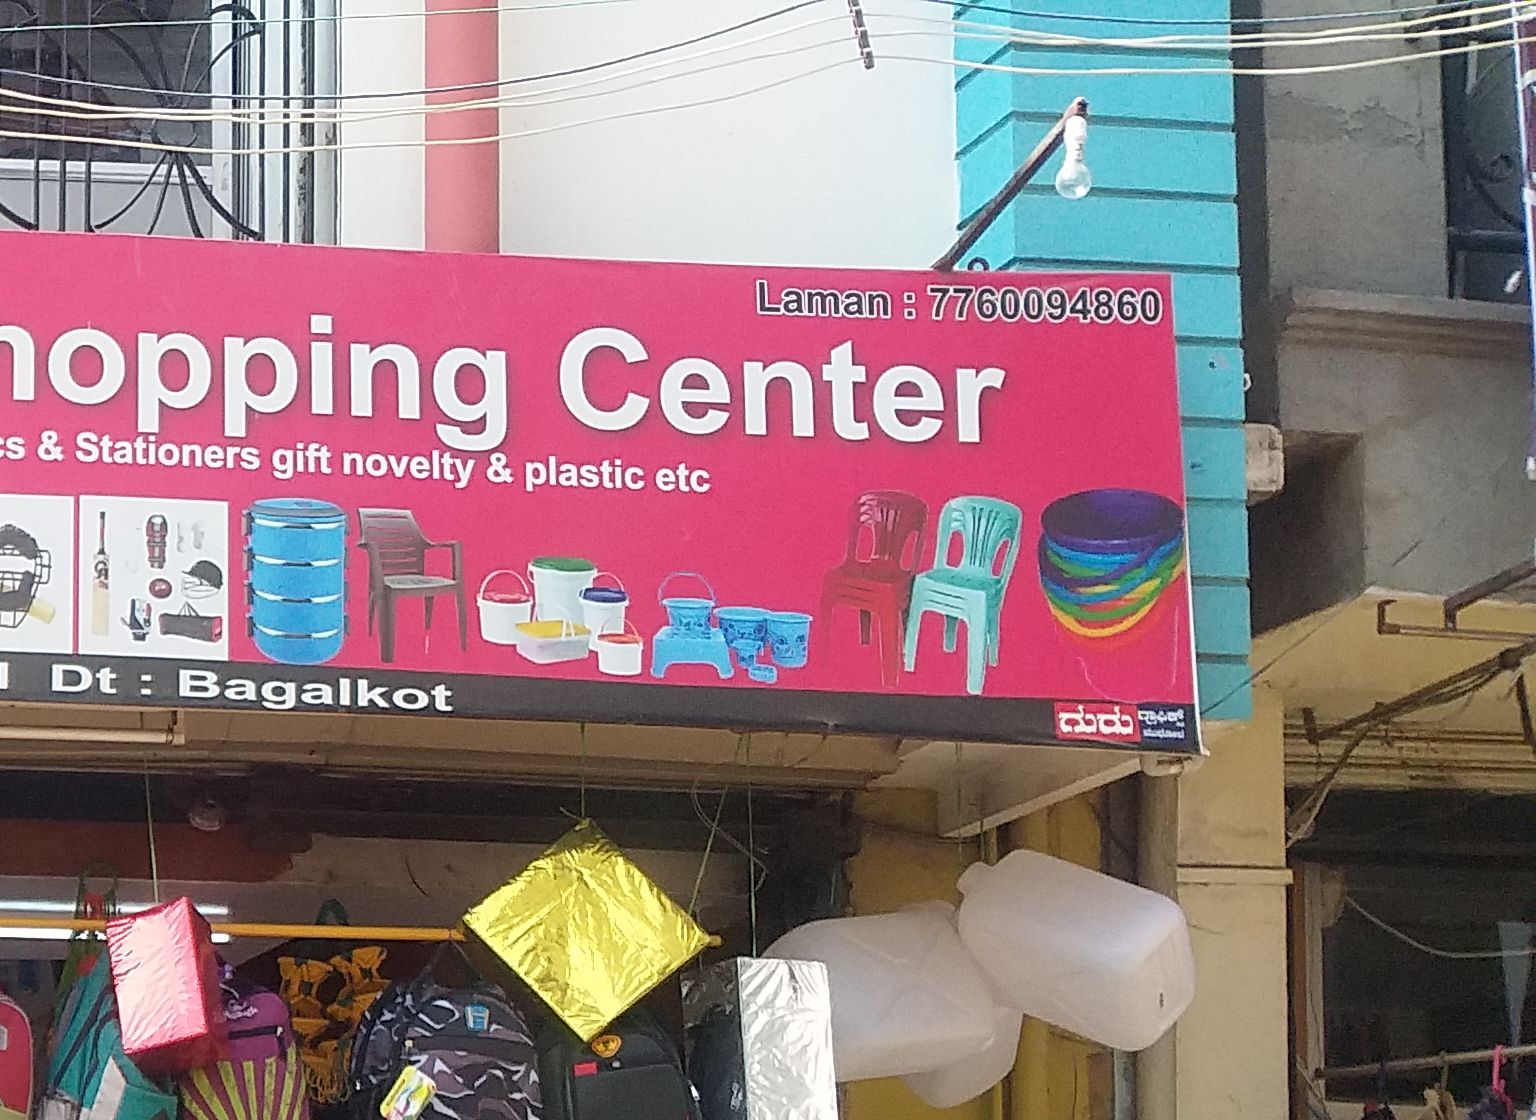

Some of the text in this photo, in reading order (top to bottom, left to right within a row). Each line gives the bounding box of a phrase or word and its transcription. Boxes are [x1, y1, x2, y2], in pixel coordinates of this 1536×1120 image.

[756, 280, 1163, 326] Laman : 7760094860
[558, 327, 1006, 444] Center
[37, 430, 65, 462] &
[75, 437, 261, 470] Stationers
[272, 447, 332, 480] gift
[342, 451, 476, 488] novelty
[486, 453, 514, 484] &
[525, 456, 645, 491] plastic
[655, 462, 711, 493] etc
[51, 663, 117, 694] Dt
[140, 674, 152, 695] :
[178, 669, 453, 712] Bagalkot
[1058, 704, 1134, 735] ಗುರು
